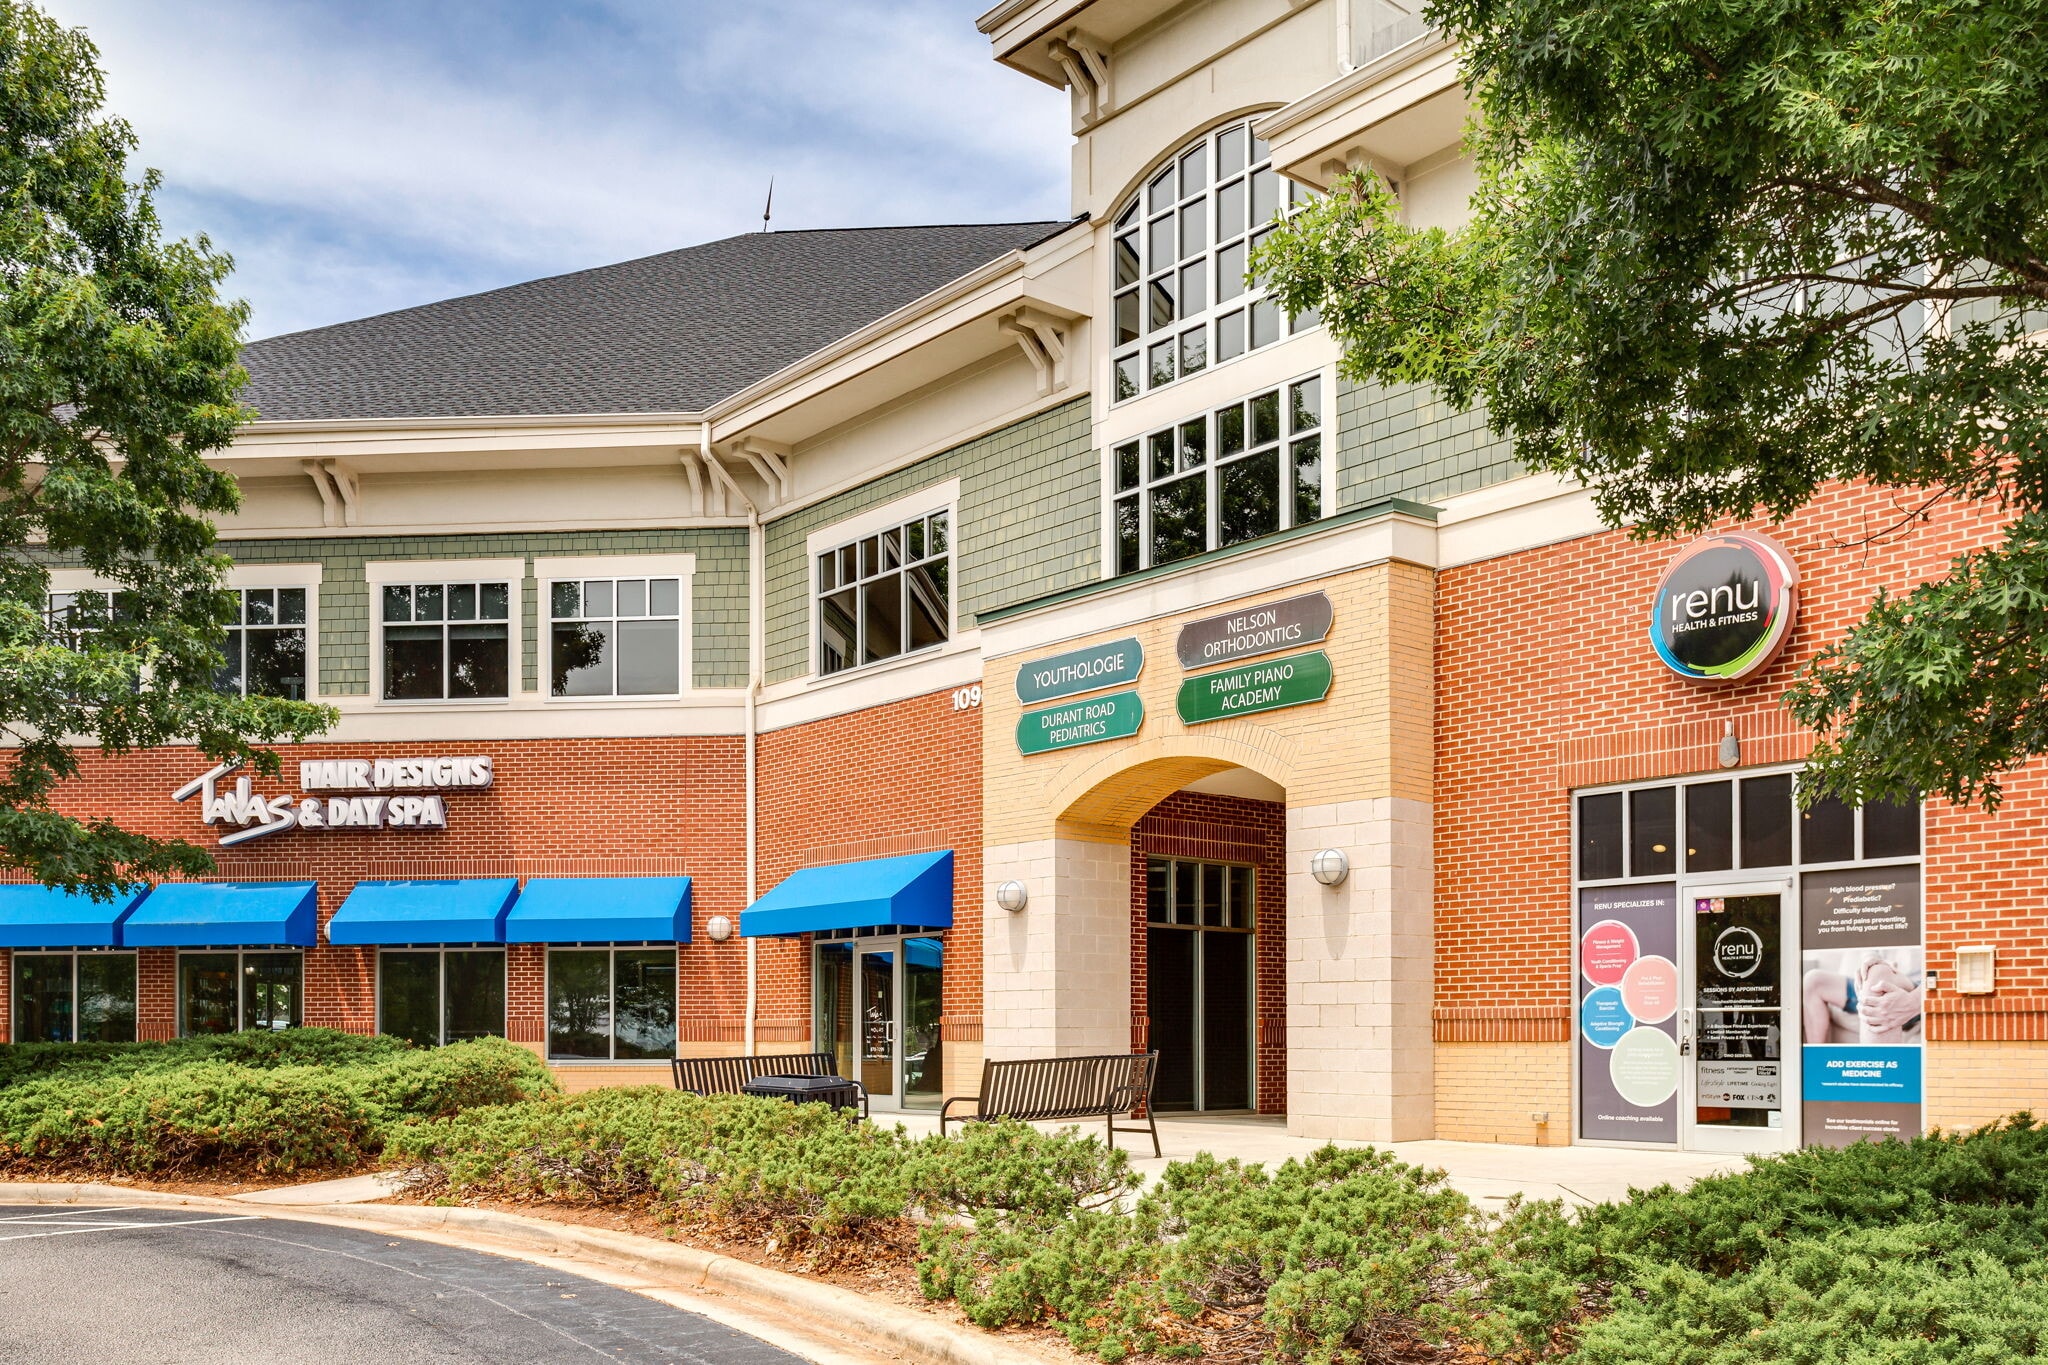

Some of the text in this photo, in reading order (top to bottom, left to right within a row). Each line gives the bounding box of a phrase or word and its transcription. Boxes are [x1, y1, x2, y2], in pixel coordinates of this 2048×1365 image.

[1672, 580, 1759, 621] renu
[1226, 610, 1276, 635] NELSON
[1672, 611, 1758, 633] HEALTH & FITNESS
[1203, 623, 1302, 659] ORTHODONTICS
[1033, 652, 1125, 689] YOUTHOLOGIE
[1210, 663, 1294, 695] FAMILY PIANO
[951, 686, 983, 711] 109
[1221, 685, 1283, 712] ACADEMY
[1041, 701, 1116, 730] DURANT ROAD
[1049, 721, 1106, 745] PEDIATRICS
[301, 756, 493, 791] HAIR DESIGNS
[298, 795, 447, 829] & DAY SPA
[1829, 886, 1844, 894] High
[1865, 882, 1896, 893] pressure?
[1843, 895, 1882, 903] Prediabetic?
[1594, 903, 1612, 911] RENU
[1613, 900, 1655, 909] SPECIALIZES
[1833, 905, 1892, 915] Difficulty sleeping?
[1818, 926, 1830, 934] you
[1864, 924, 1879, 932] your
[1853, 917, 1870, 925] pains
[1871, 916, 1906, 924] preventing
[1721, 943, 1754, 955] renu
[1701, 1066, 1725, 1074] fitness
[1826, 1060, 1898, 1069] ADD EXERCISE AS
[1842, 1070, 1882, 1078] MEDICINE
